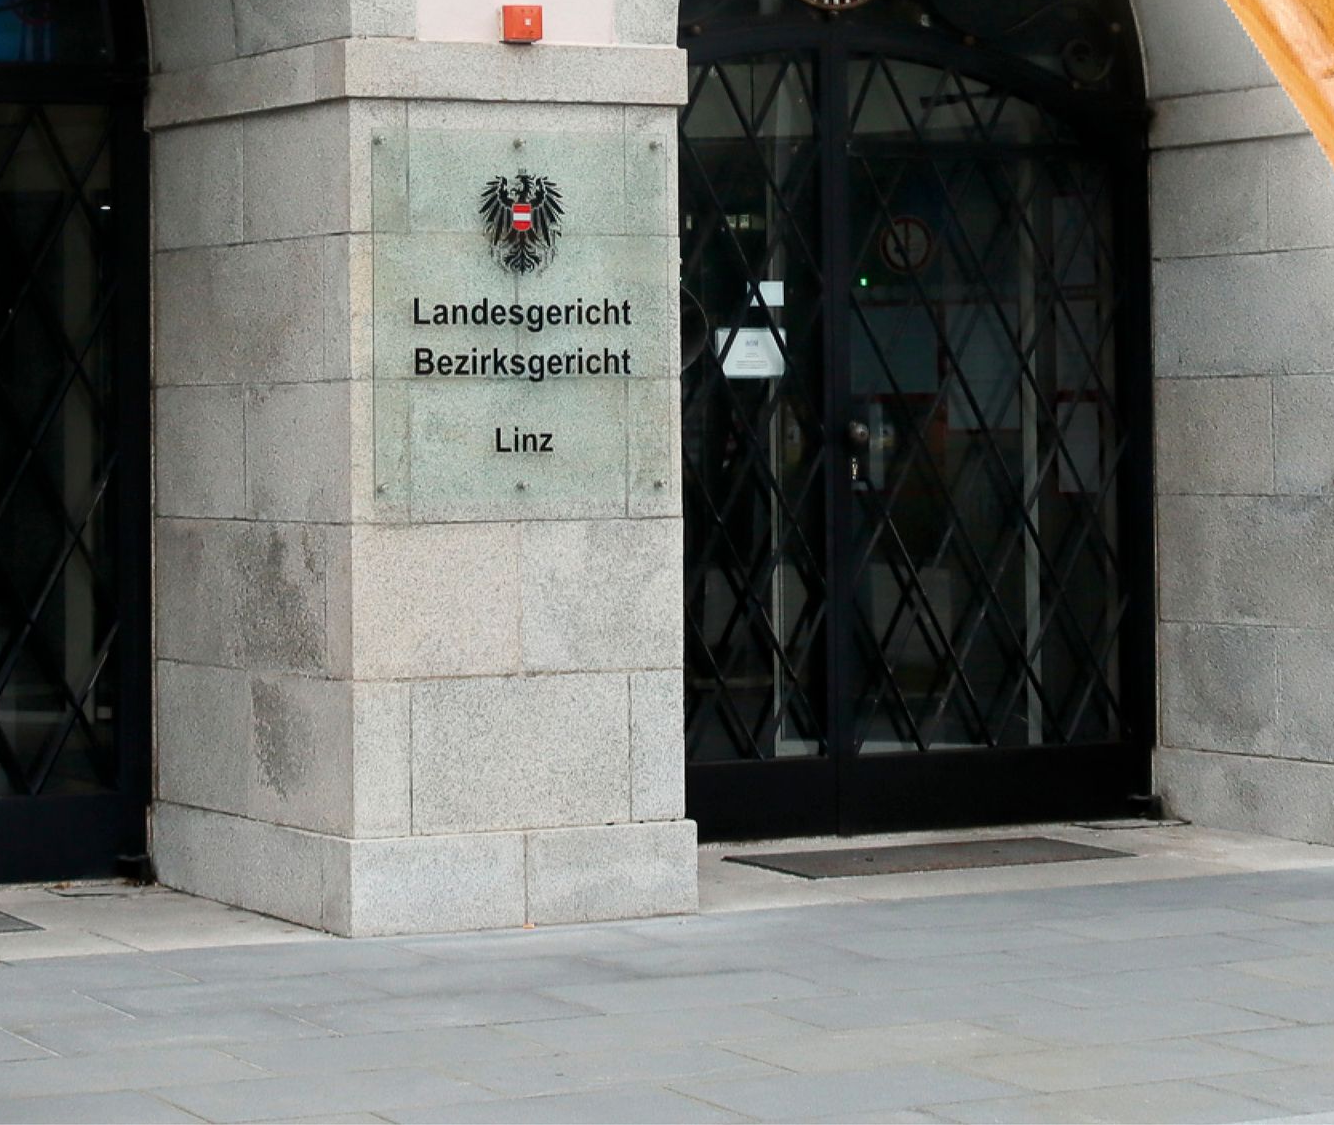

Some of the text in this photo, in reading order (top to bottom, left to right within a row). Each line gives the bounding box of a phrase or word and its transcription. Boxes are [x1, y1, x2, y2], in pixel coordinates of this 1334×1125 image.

[413, 298, 631, 332] Landesgericht
[415, 347, 631, 382] Bezirksgericht
[496, 427, 554, 453] Linz
